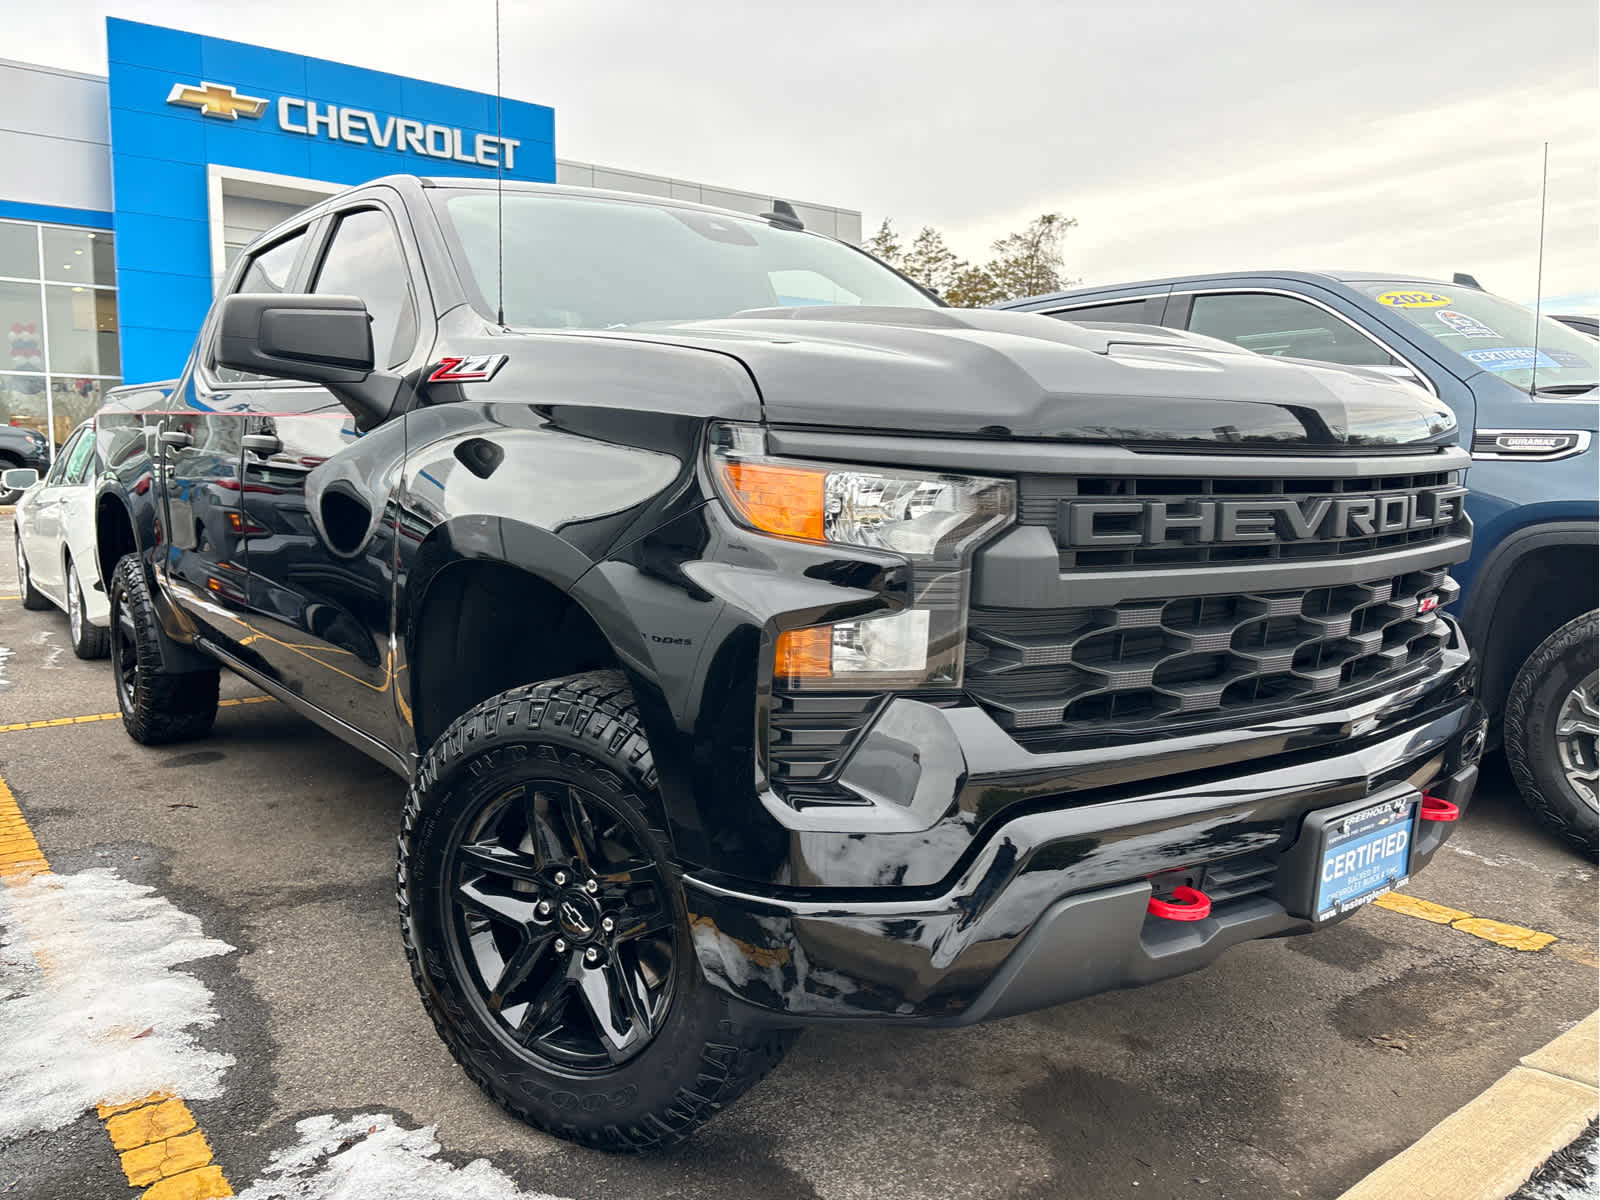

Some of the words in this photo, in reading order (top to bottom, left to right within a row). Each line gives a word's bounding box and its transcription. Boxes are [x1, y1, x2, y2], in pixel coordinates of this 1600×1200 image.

[277, 96, 521, 169] CHEVROLET
[1467, 349, 1539, 362] CERTIFIED
[1507, 438, 1556, 446] DURAMAX
[1322, 830, 1408, 882] CERTIFIED
